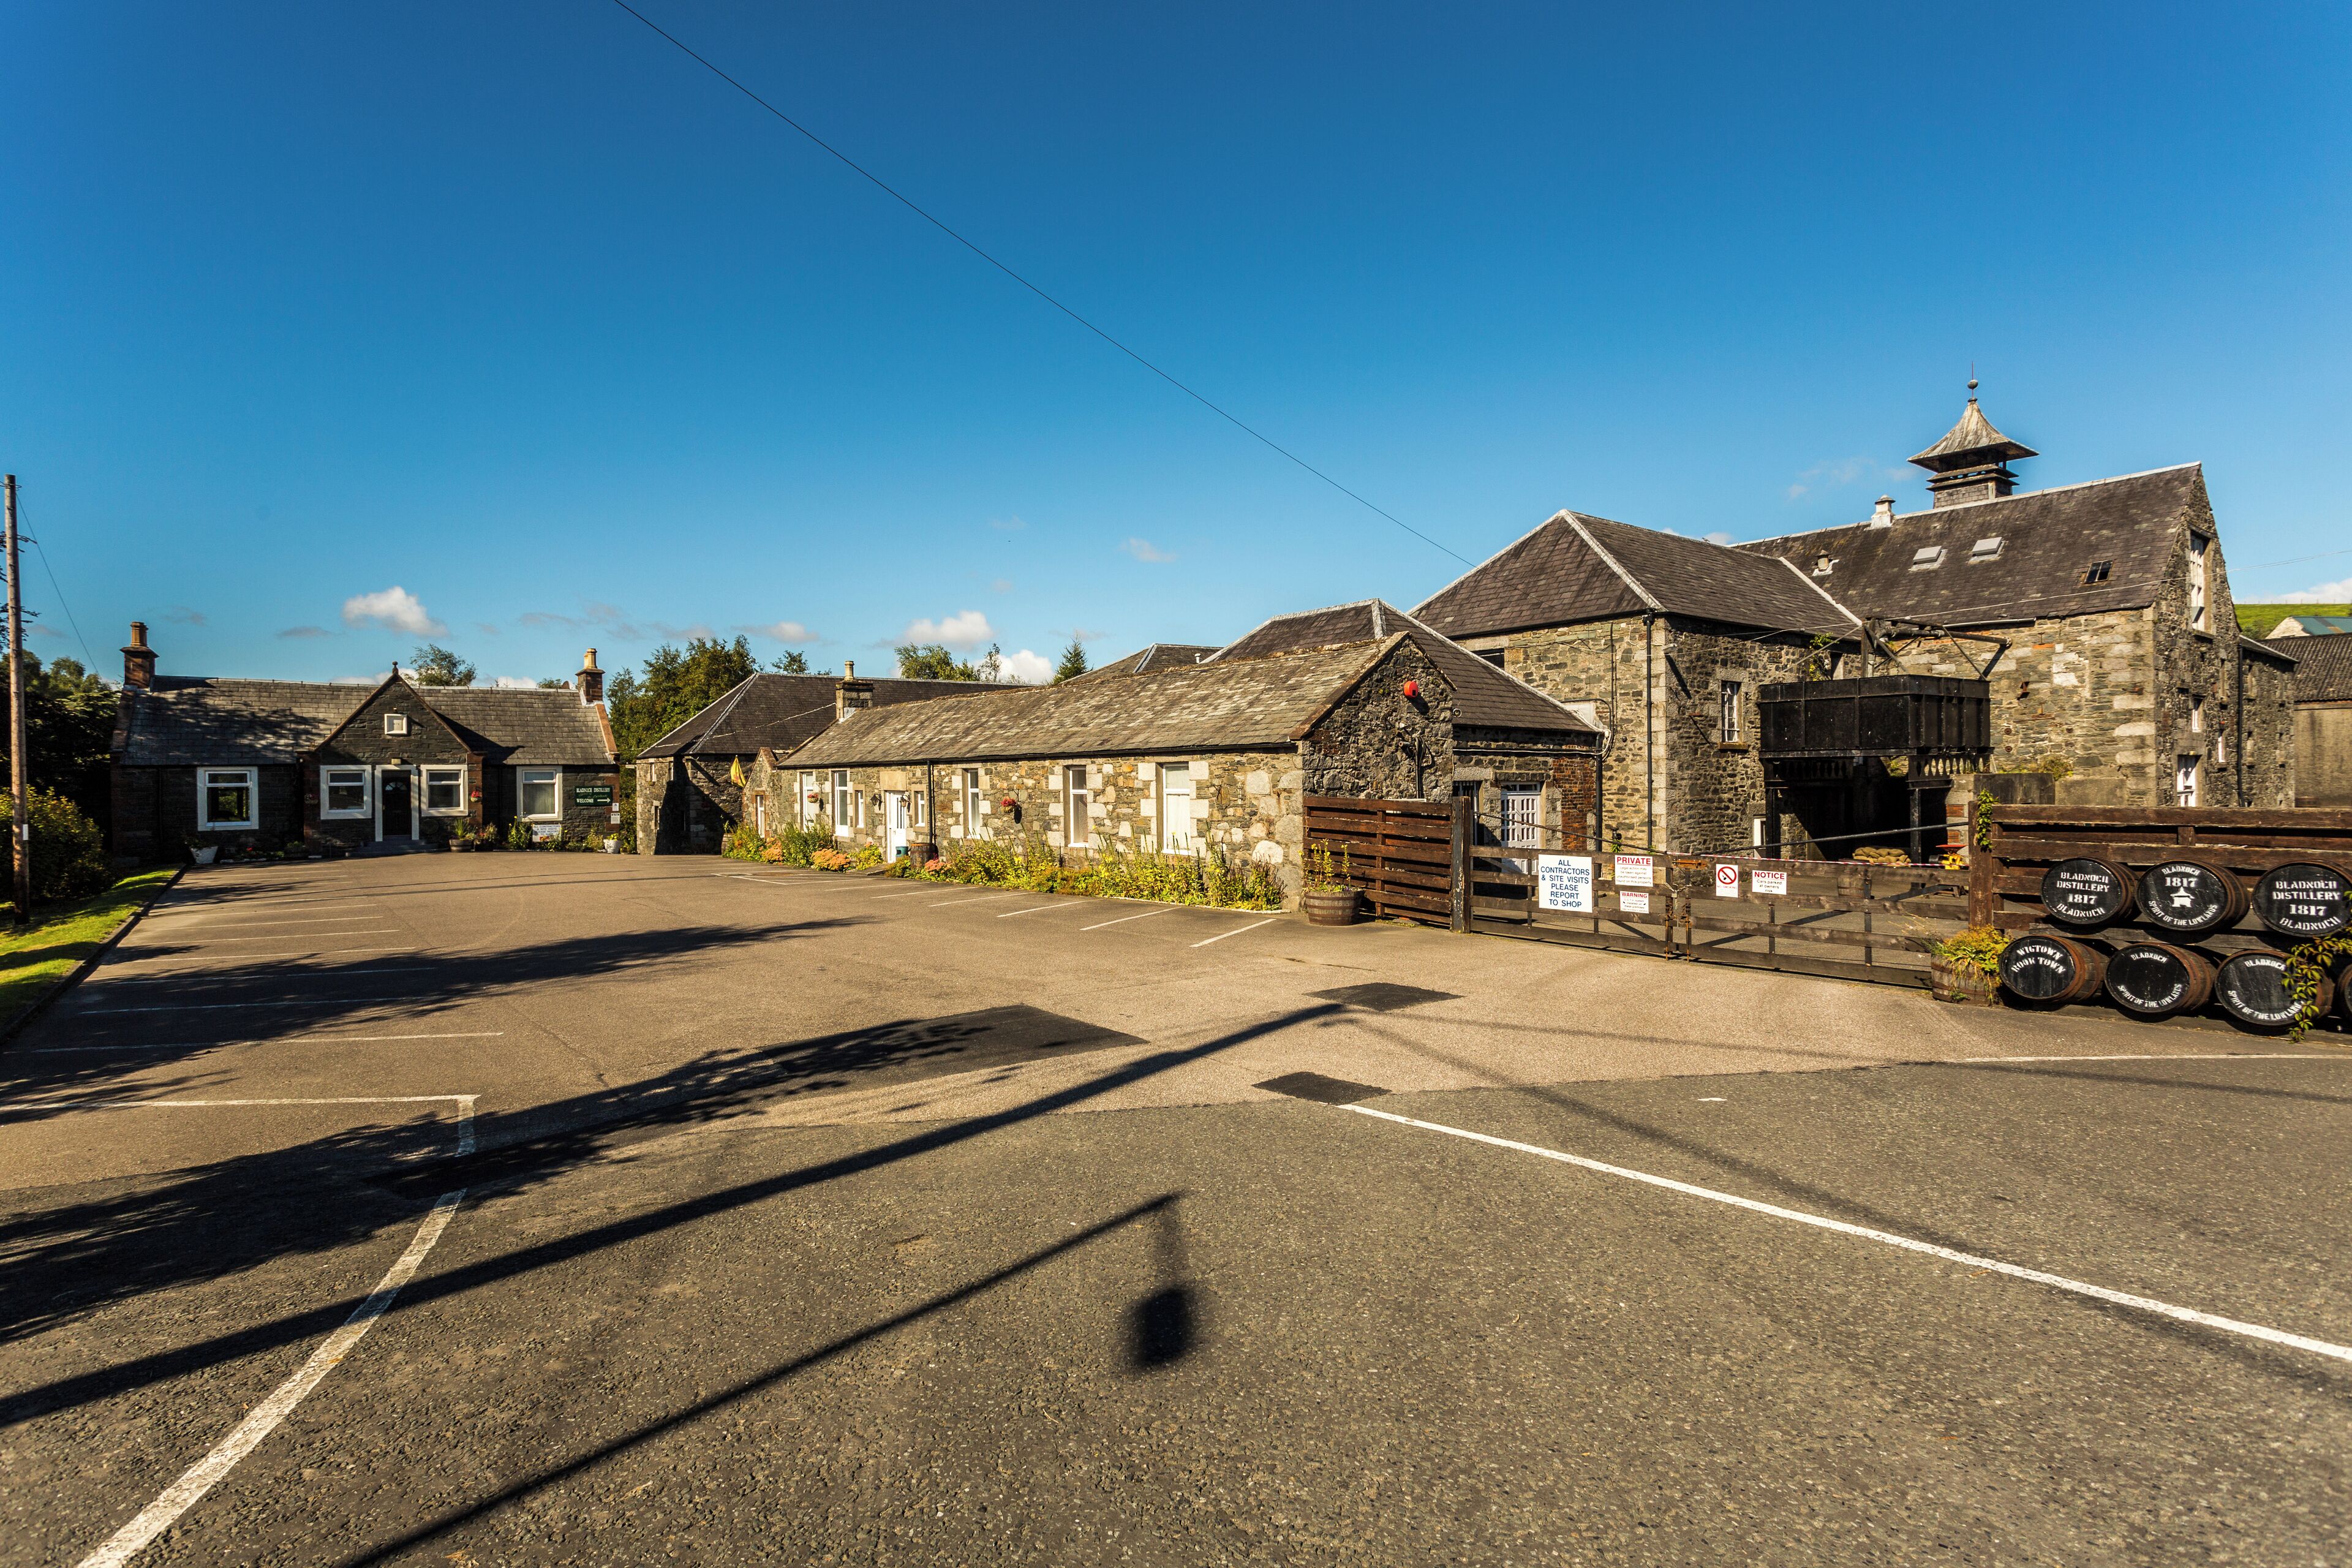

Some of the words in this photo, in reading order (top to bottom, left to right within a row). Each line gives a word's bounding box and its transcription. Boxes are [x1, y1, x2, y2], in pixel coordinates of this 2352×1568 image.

[1616, 856, 1651, 865] PRIVATE
[1540, 866, 1590, 876] CONTRACTORS
[1754, 871, 1785, 880] NOTICE
[2161, 865, 2201, 876] BLADNOCH
[2060, 872, 2109, 883] BLADNOCH
[2165, 877, 2198, 888] 1817
[2056, 881, 2110, 892] DISTILLERY
[2068, 893, 2097, 905] 1817
[2272, 891, 2340, 900] DISTILLERY
[2056, 903, 2106, 917] BLADNOCH
[2148, 900, 2165, 918] SPIRIT
[2188, 904, 2218, 925] LOWLANDS
[2290, 904, 2328, 916] 1817
[2279, 916, 2342, 930] BLADNOCH
[2016, 945, 2064, 960] WIGTOWN
[2130, 952, 2168, 963] BLADNOCH
[2037, 957, 2067, 974] TOWN
[2117, 985, 2136, 1001] SPIRIT
[2158, 984, 2182, 1006] LOWLANDS
[2228, 990, 2245, 1008] SPIRIT
[2242, 1006, 2254, 1015] OF
[2253, 1011, 2270, 1020] THE
